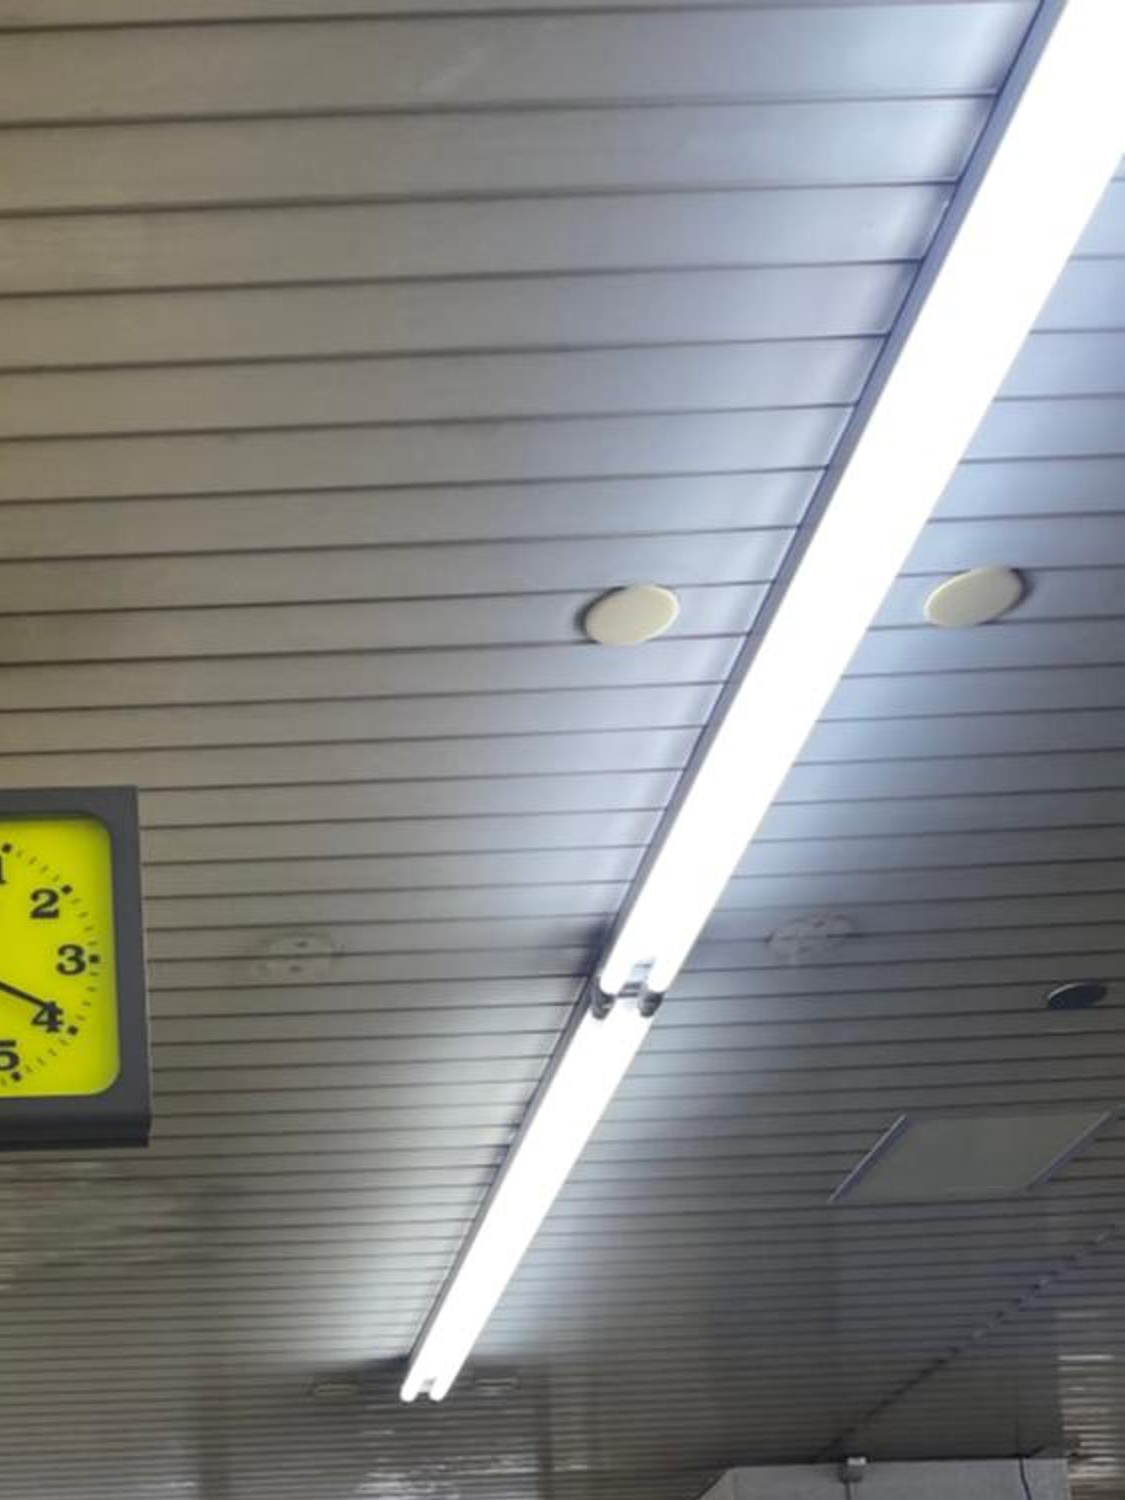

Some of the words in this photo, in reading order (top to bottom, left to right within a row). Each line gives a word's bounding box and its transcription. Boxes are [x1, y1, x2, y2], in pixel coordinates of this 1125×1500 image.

[29, 888, 60, 919] 2
[56, 944, 87, 975] 3
[30, 1001, 65, 1033] 4
